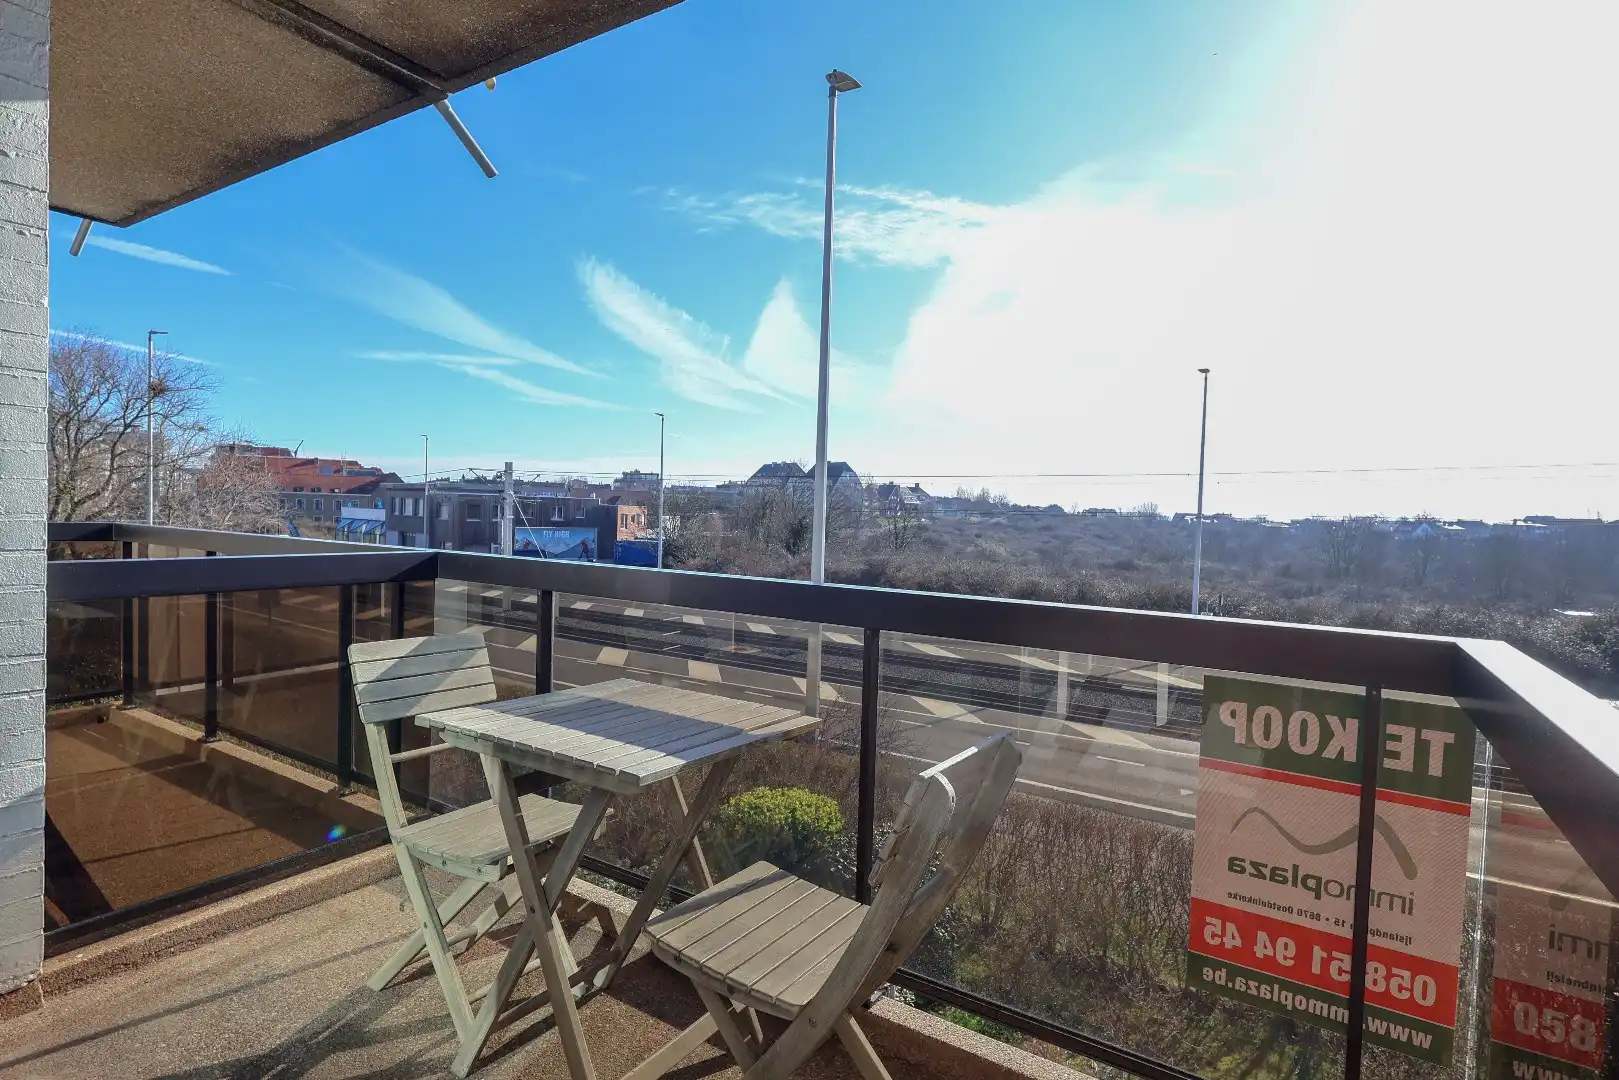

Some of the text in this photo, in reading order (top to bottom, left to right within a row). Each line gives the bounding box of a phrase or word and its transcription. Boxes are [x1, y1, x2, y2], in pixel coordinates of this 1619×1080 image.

[543, 530, 570, 538] FLY HIGH
[1513, 1001, 1597, 1050] 058
